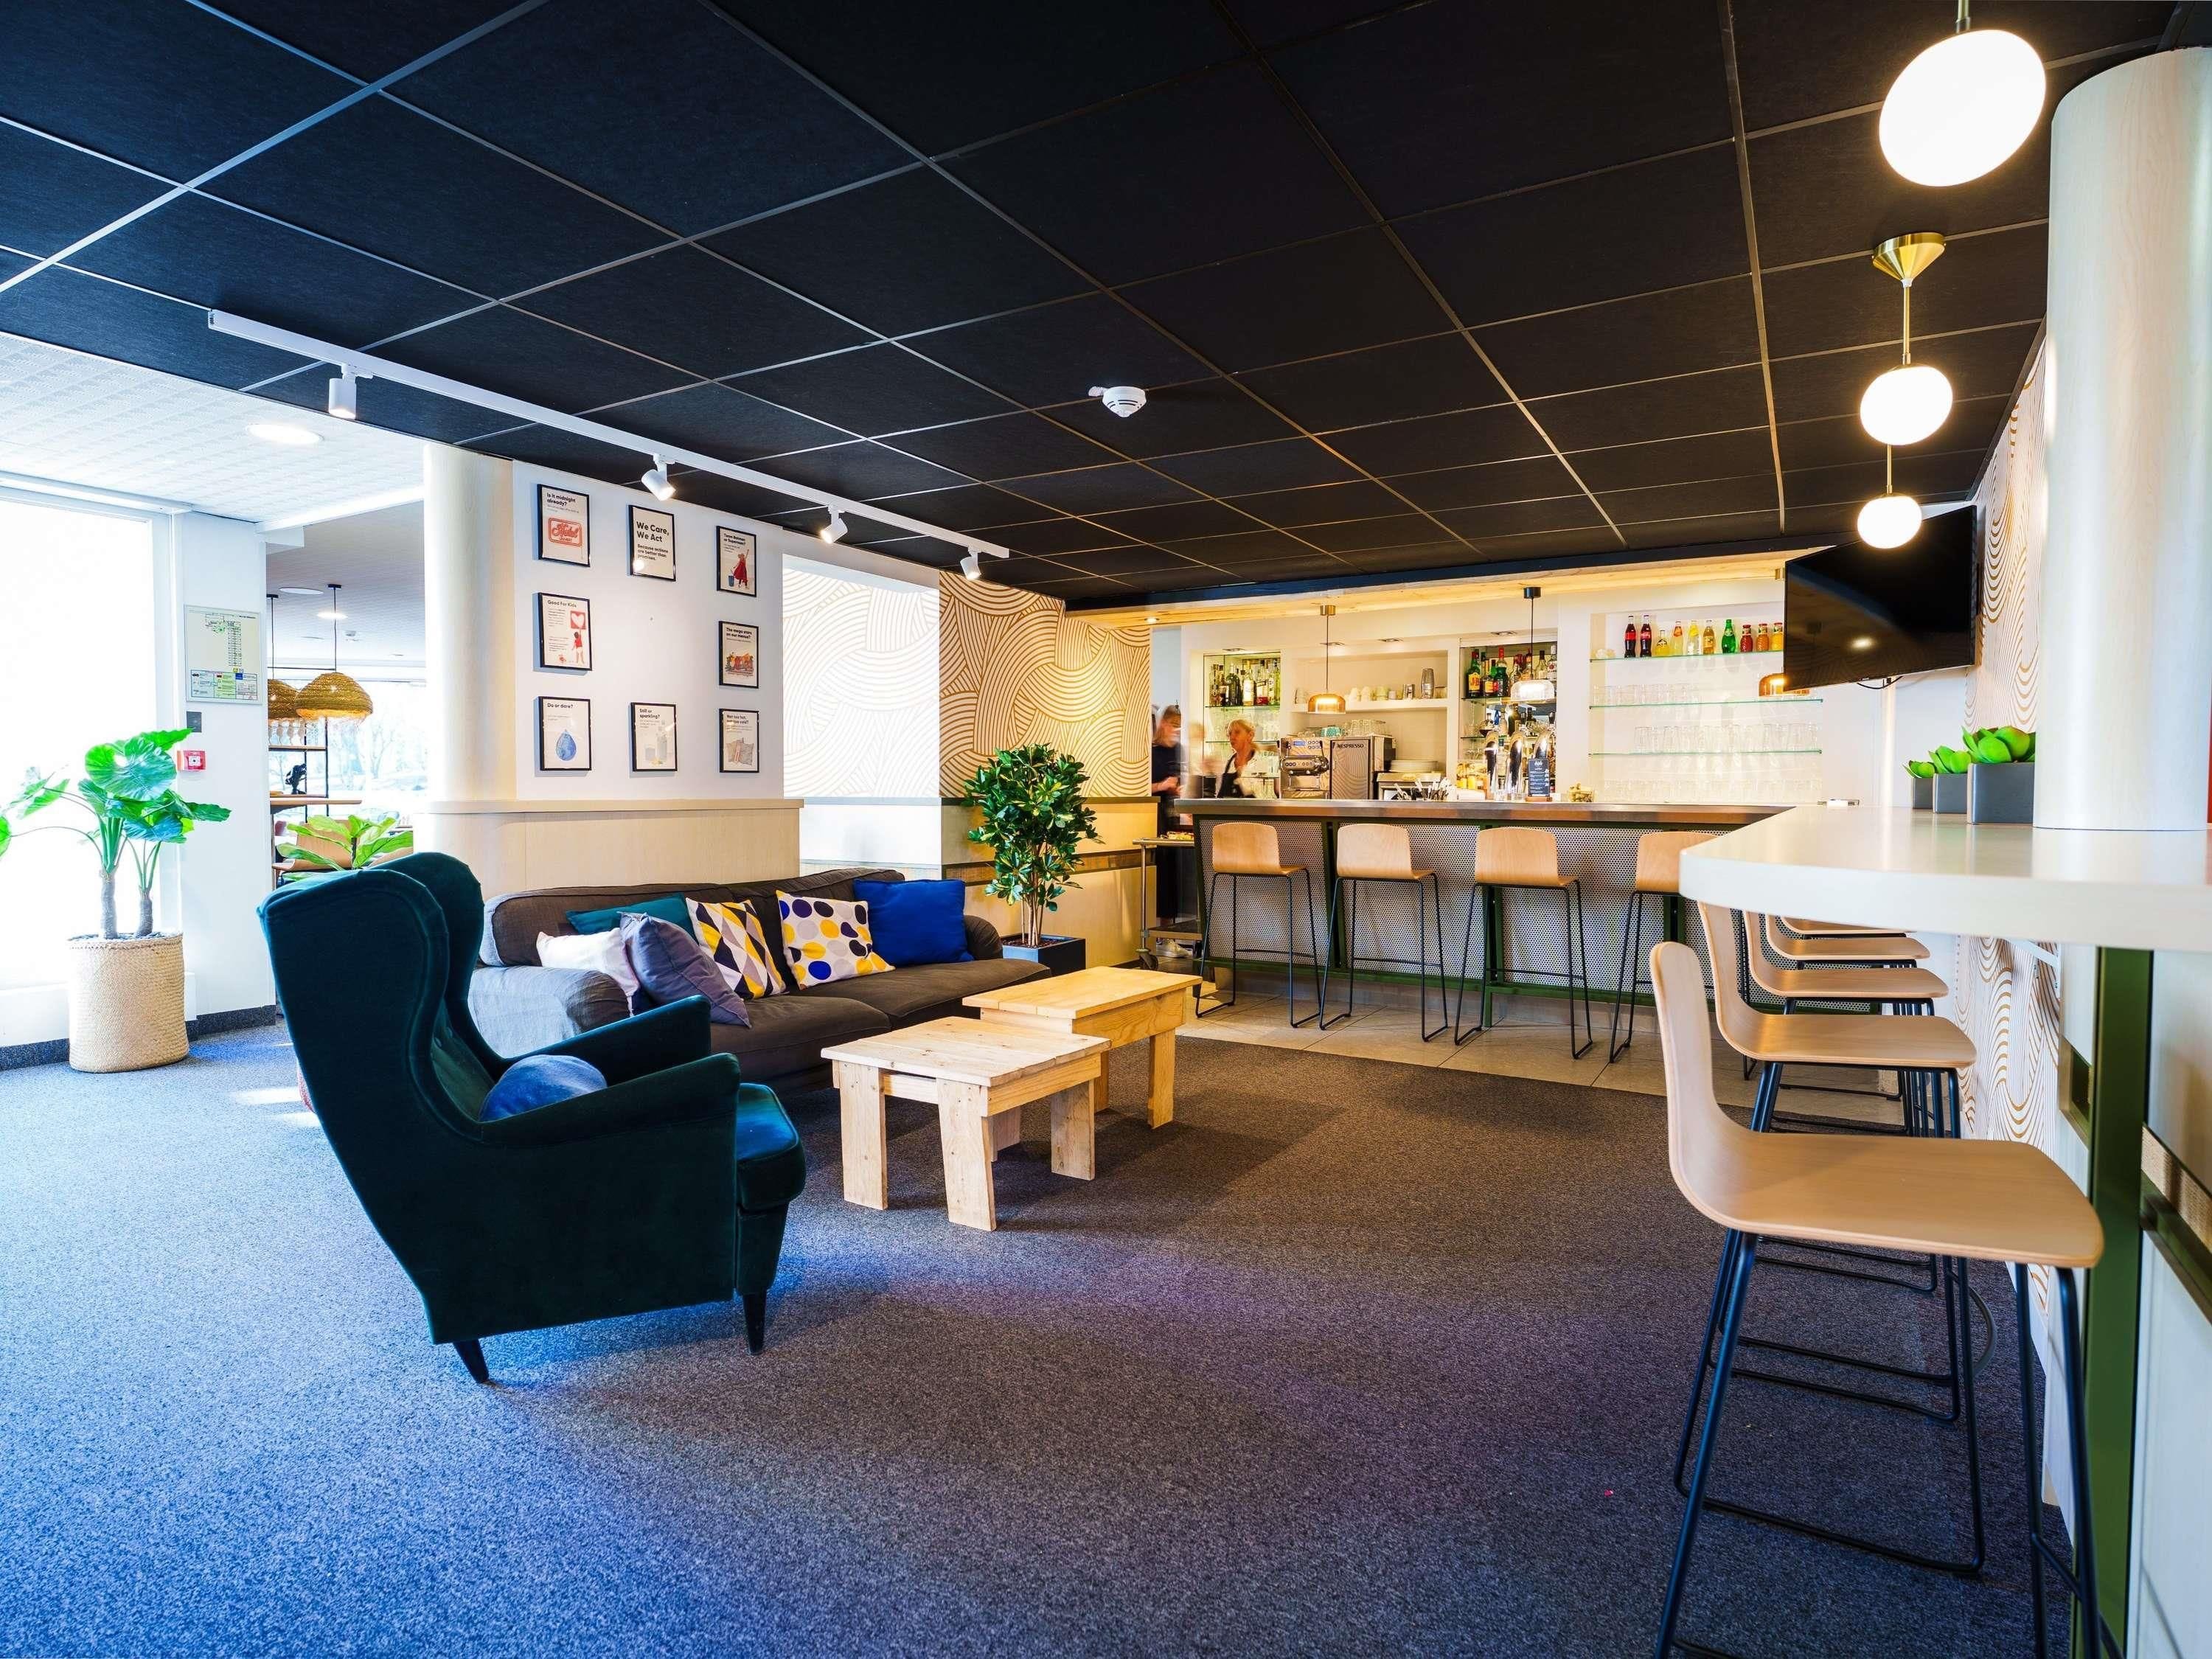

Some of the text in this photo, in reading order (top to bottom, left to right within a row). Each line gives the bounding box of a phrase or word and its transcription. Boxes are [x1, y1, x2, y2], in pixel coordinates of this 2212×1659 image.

[547, 498, 567, 507] already?
[556, 495, 576, 503] midnight
[636, 521, 669, 536] We Care,
[636, 530, 662, 543] We Act
